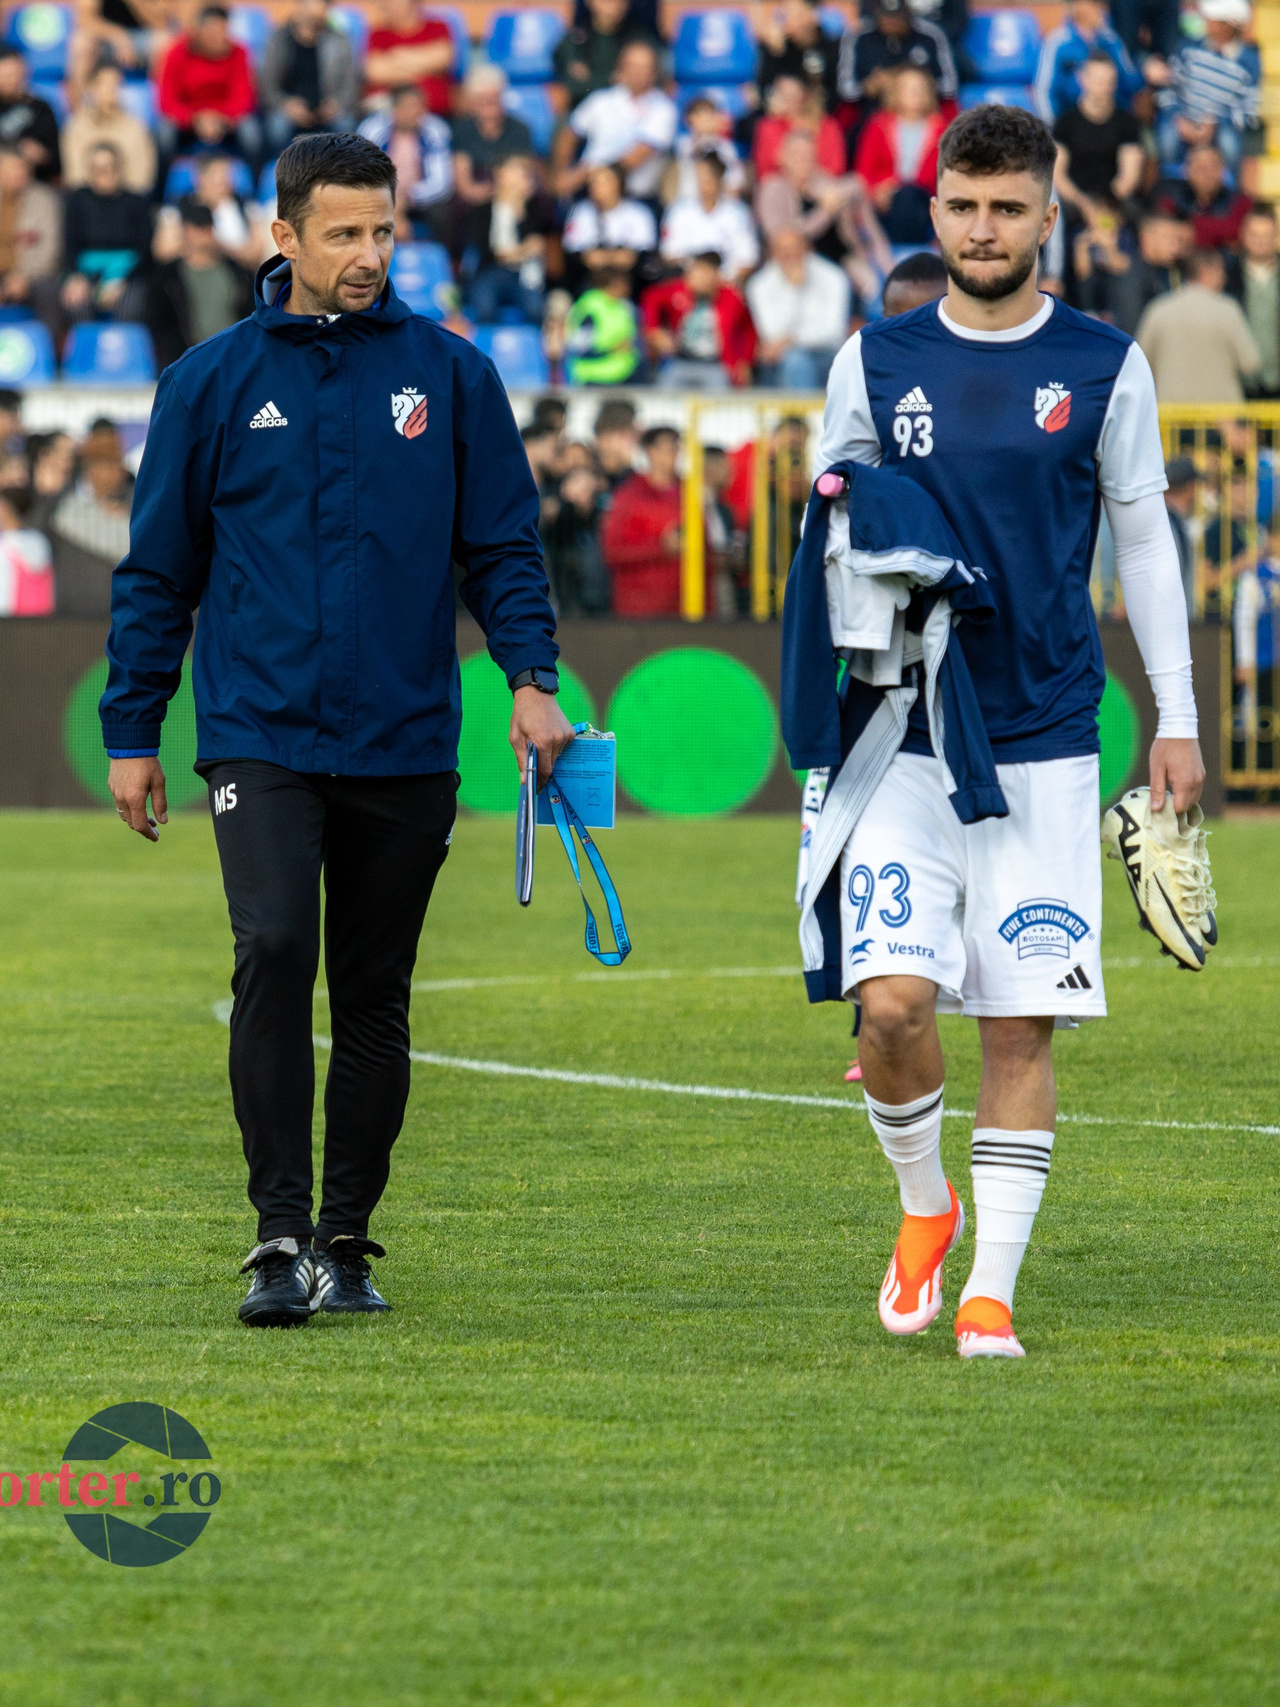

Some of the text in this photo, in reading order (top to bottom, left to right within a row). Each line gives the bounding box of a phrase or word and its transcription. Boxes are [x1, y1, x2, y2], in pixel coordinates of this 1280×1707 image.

[895, 403, 933, 414] adidas
[250, 418, 288, 429] adidas
[893, 415, 934, 457] 93
[214, 783, 237, 816] MS
[847, 861, 913, 933] 93
[588, 922, 597, 949] FOTBAL
[614, 923, 629, 952] FEDERA
[1002, 907, 1086, 939] FIVE CONTINENTS
[887, 941, 935, 959] Vestra
